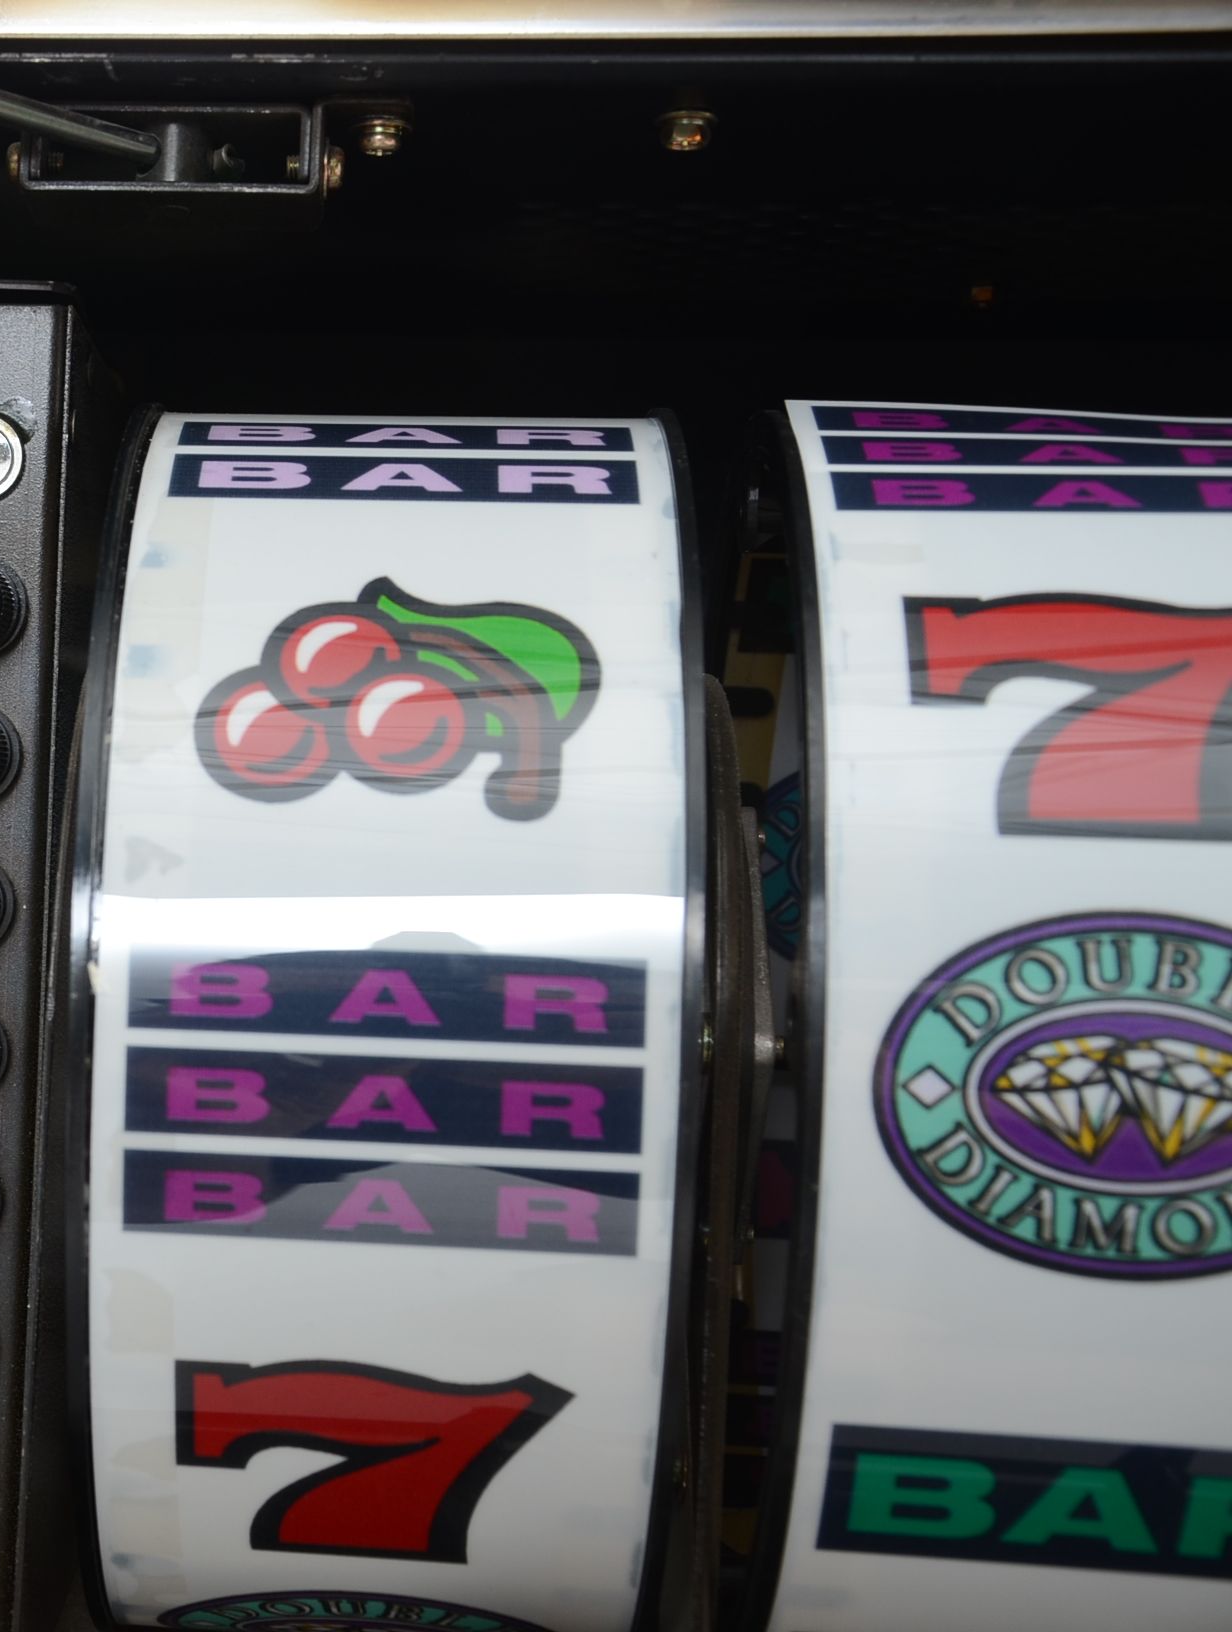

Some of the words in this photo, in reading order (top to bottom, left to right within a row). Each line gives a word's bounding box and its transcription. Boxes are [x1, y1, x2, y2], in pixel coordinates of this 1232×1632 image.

[207, 425, 607, 446] BAR
[198, 460, 612, 495] BAR
[901, 592, 1232, 841] 7
[169, 962, 609, 1033] BAR
[167, 1066, 605, 1139] BAR
[163, 1170, 600, 1243] BAR
[175, 1360, 576, 1565] 7
